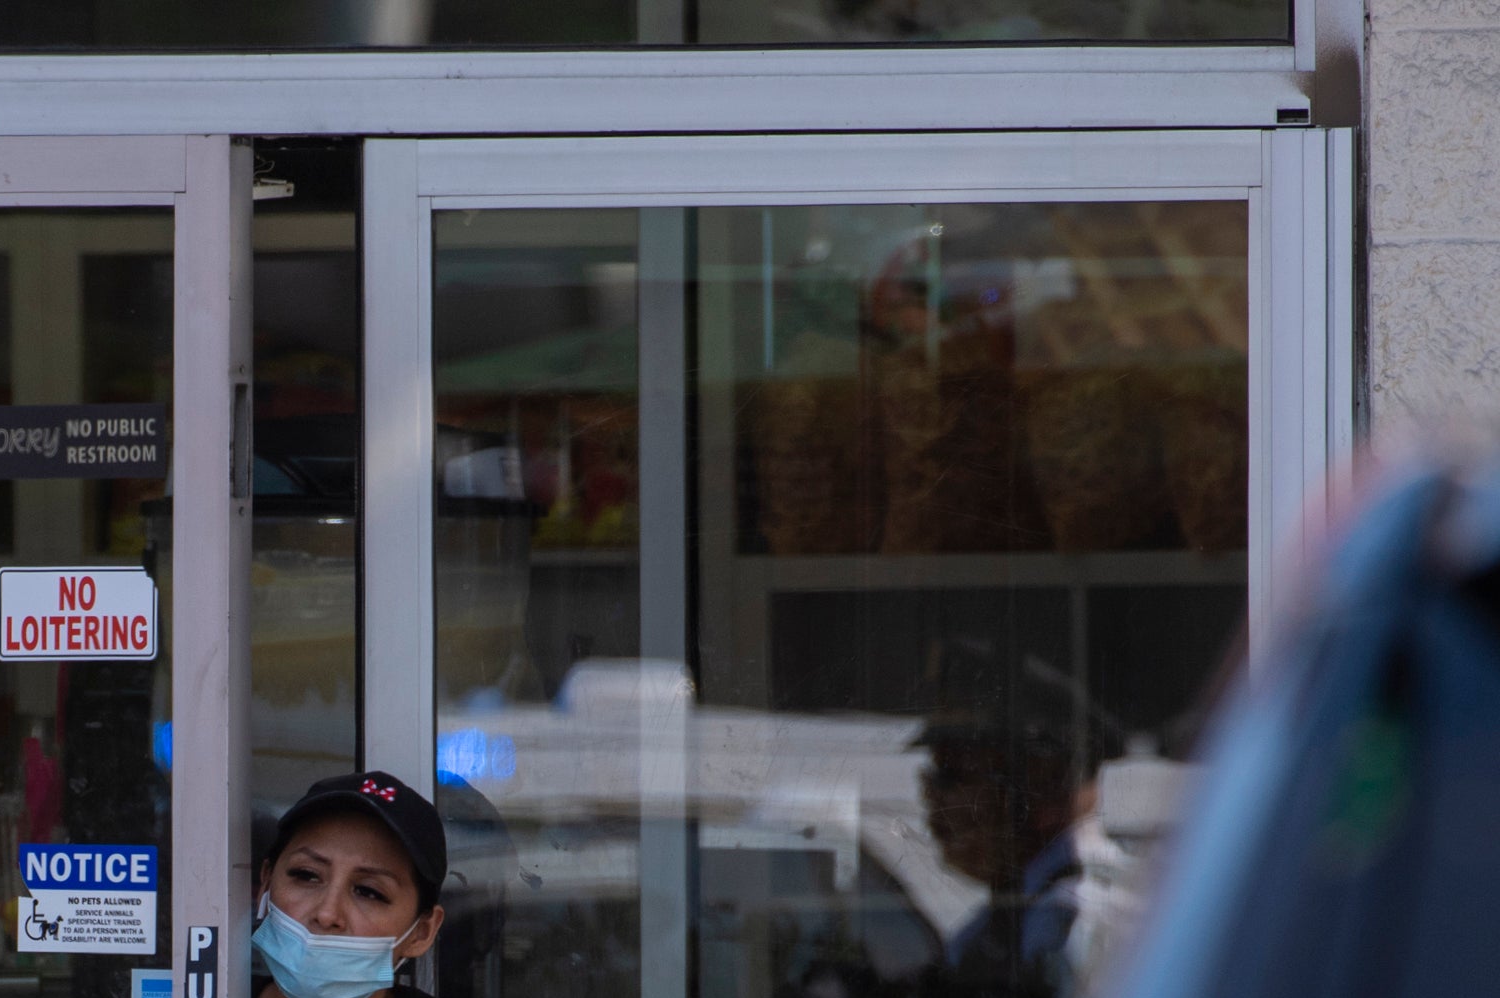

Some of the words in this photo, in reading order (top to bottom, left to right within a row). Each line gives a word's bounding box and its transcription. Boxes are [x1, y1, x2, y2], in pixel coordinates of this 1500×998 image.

[65, 419, 92, 438] NO
[97, 417, 157, 437] PUBLIC
[67, 444, 157, 464] RESTROOM
[59, 575, 96, 611] NO
[6, 615, 148, 651] LOITERING
[26, 852, 150, 883] NOTICE
[68, 897, 79, 905] NO
[82, 897, 101, 905] PETS
[104, 898, 142, 906] ALLOWED
[67, 918, 111, 926] SPECIFICALLY
